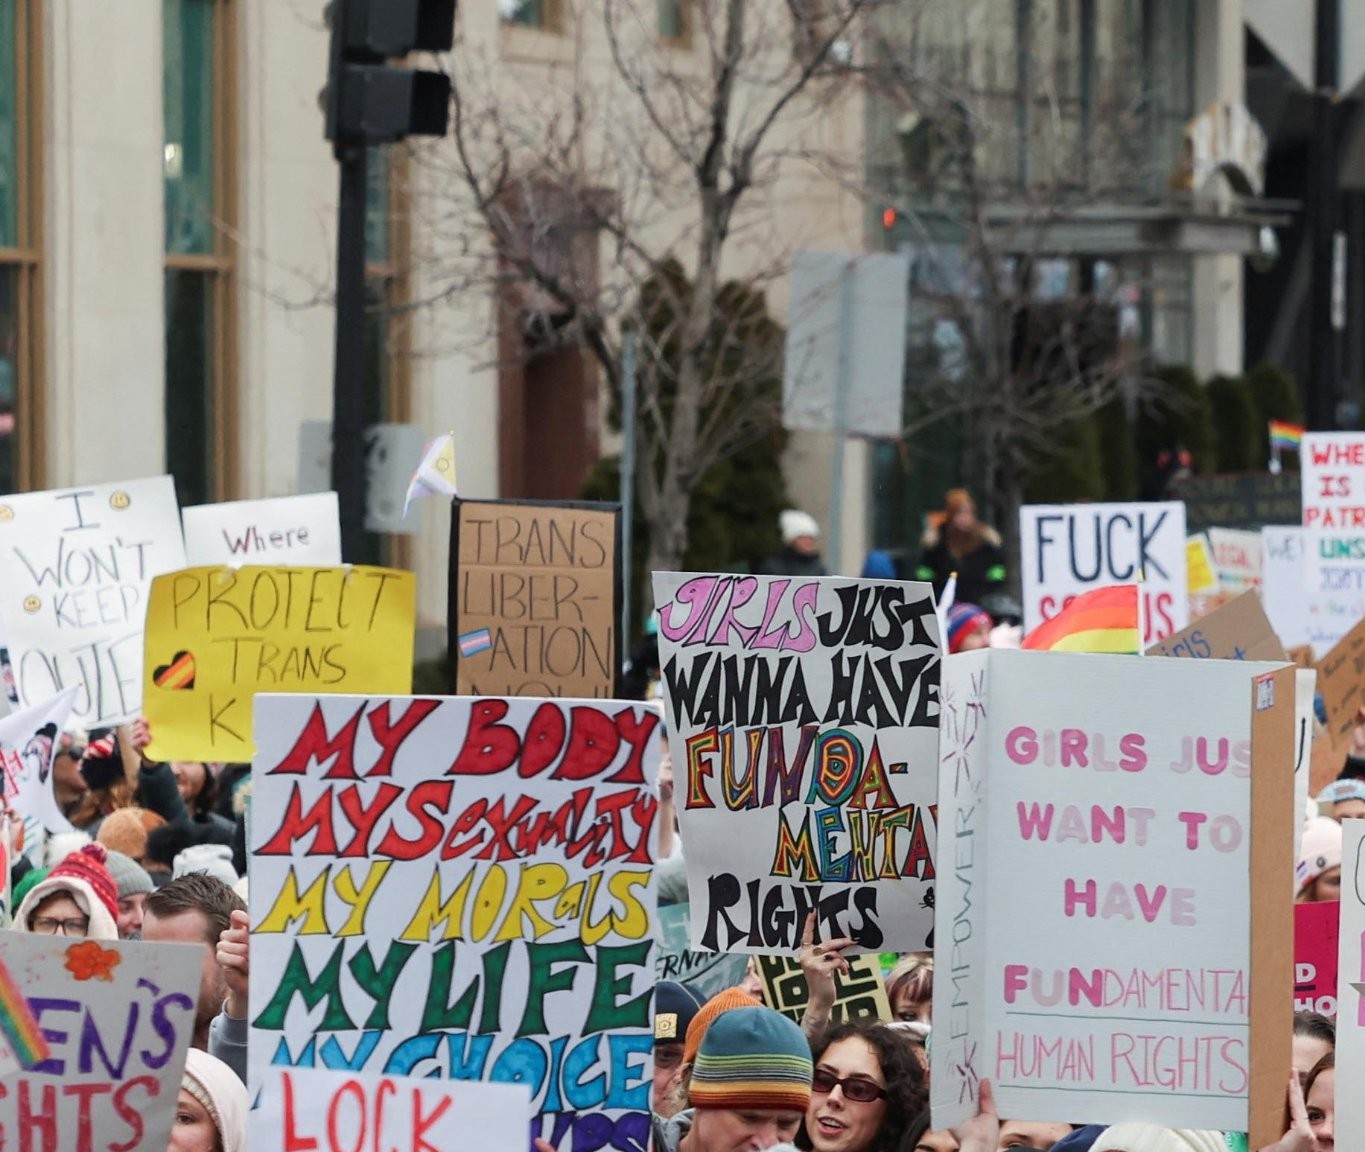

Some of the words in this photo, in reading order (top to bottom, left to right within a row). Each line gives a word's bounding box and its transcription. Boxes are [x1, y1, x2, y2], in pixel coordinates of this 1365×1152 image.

[55, 491, 100, 532] I
[1319, 476, 1349, 496] IS
[13, 536, 153, 588] WON'T
[223, 526, 309, 555] Where
[466, 518, 606, 568] TRANS
[1036, 511, 1170, 583] FUCK
[53, 584, 139, 628] KEEP
[173, 571, 400, 632] PROTECT
[657, 576, 817, 651] GIRLS
[817, 585, 938, 651] JUST
[212, 637, 346, 683] TRANS
[488, 626, 611, 680] ATION
[664, 654, 815, 731] WANNA
[823, 652, 941, 730] HAVE
[272, 700, 442, 781] MY
[447, 700, 660, 786] BODY
[1005, 726, 1148, 773] GIRLS
[253, 781, 404, 858] MY
[1016, 800, 1155, 847] WANT
[1178, 811, 1243, 853] TO
[250, 860, 395, 938] MY
[699, 882, 884, 952] RIGHTS
[1064, 877, 1197, 927] HAVE
[252, 938, 420, 1032] MY
[418, 937, 655, 1038] LIFE
[1004, 964, 1247, 1016] FUNDAMENTA
[997, 1031, 1096, 1084] HUMAN
[1110, 1034, 1248, 1093] RIGHTS
